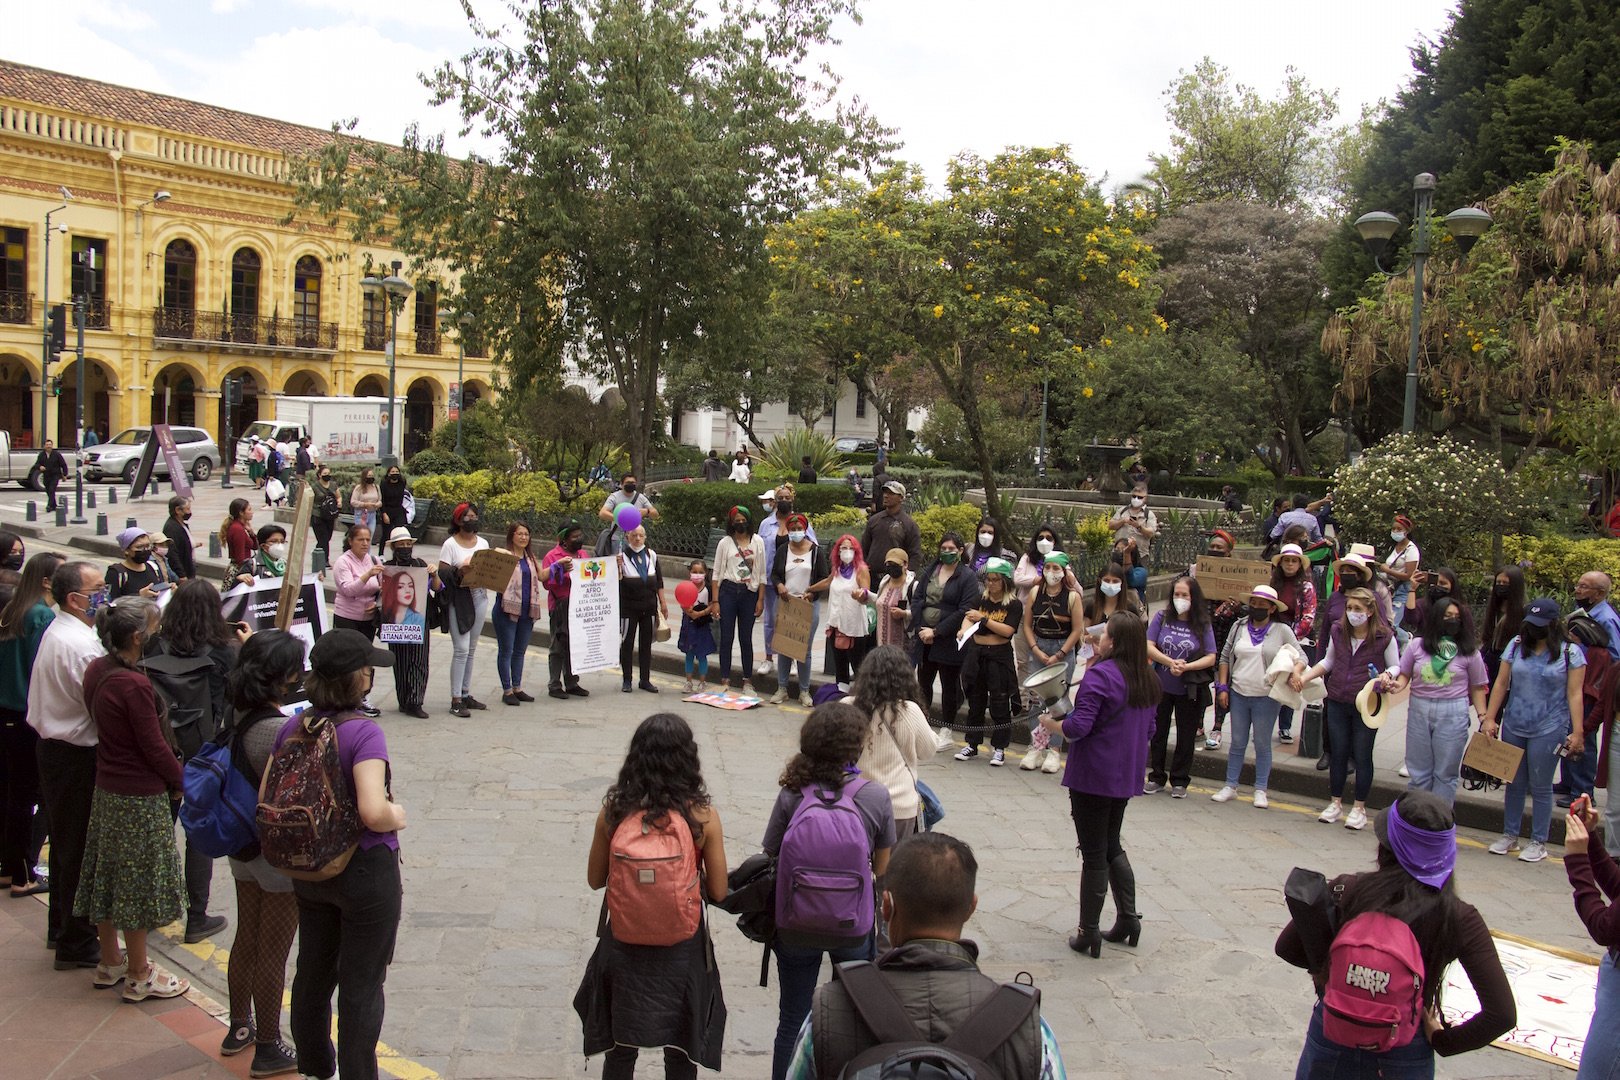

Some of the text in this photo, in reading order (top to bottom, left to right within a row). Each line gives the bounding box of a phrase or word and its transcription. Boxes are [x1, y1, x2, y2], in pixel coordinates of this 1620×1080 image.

[1201, 562, 1213, 572] Me
[1348, 964, 1390, 982] LINKIN
[1346, 972, 1387, 998] PARK
